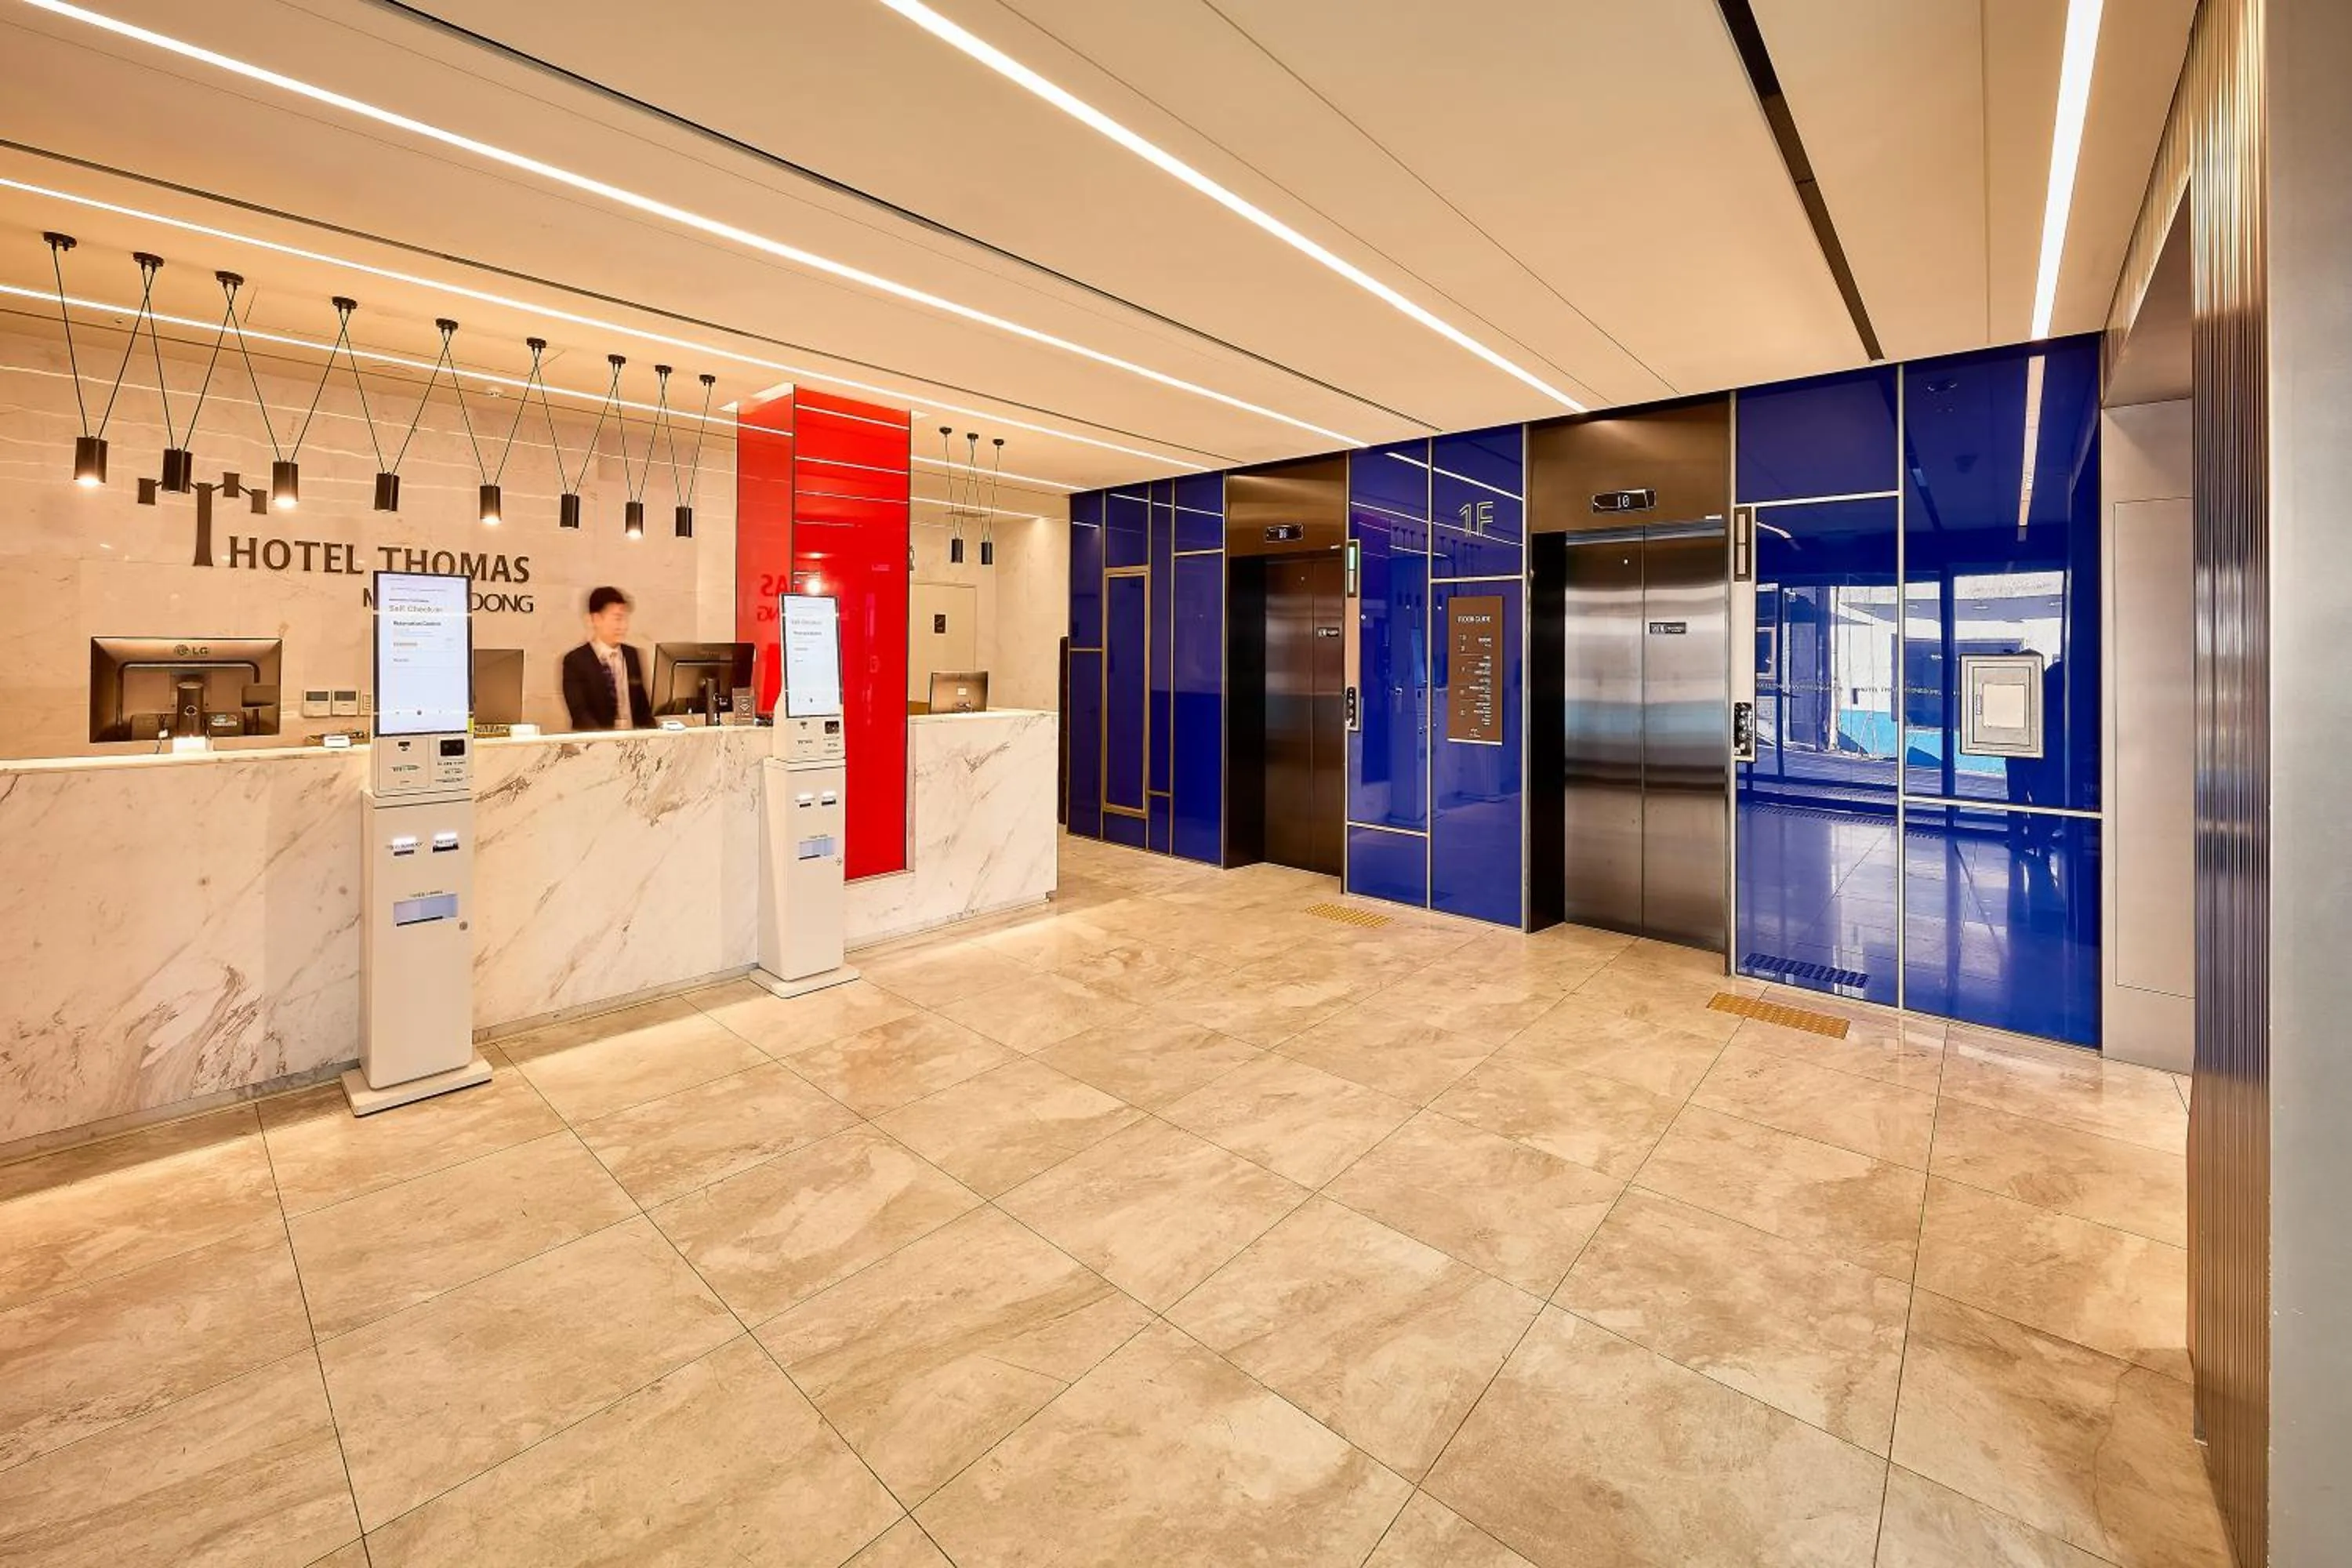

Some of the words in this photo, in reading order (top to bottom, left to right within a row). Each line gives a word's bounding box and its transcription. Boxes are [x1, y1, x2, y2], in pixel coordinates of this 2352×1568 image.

[1458, 501, 1494, 537] 1F
[229, 535, 364, 574] HOTEL
[377, 546, 530, 583] THOMAS
